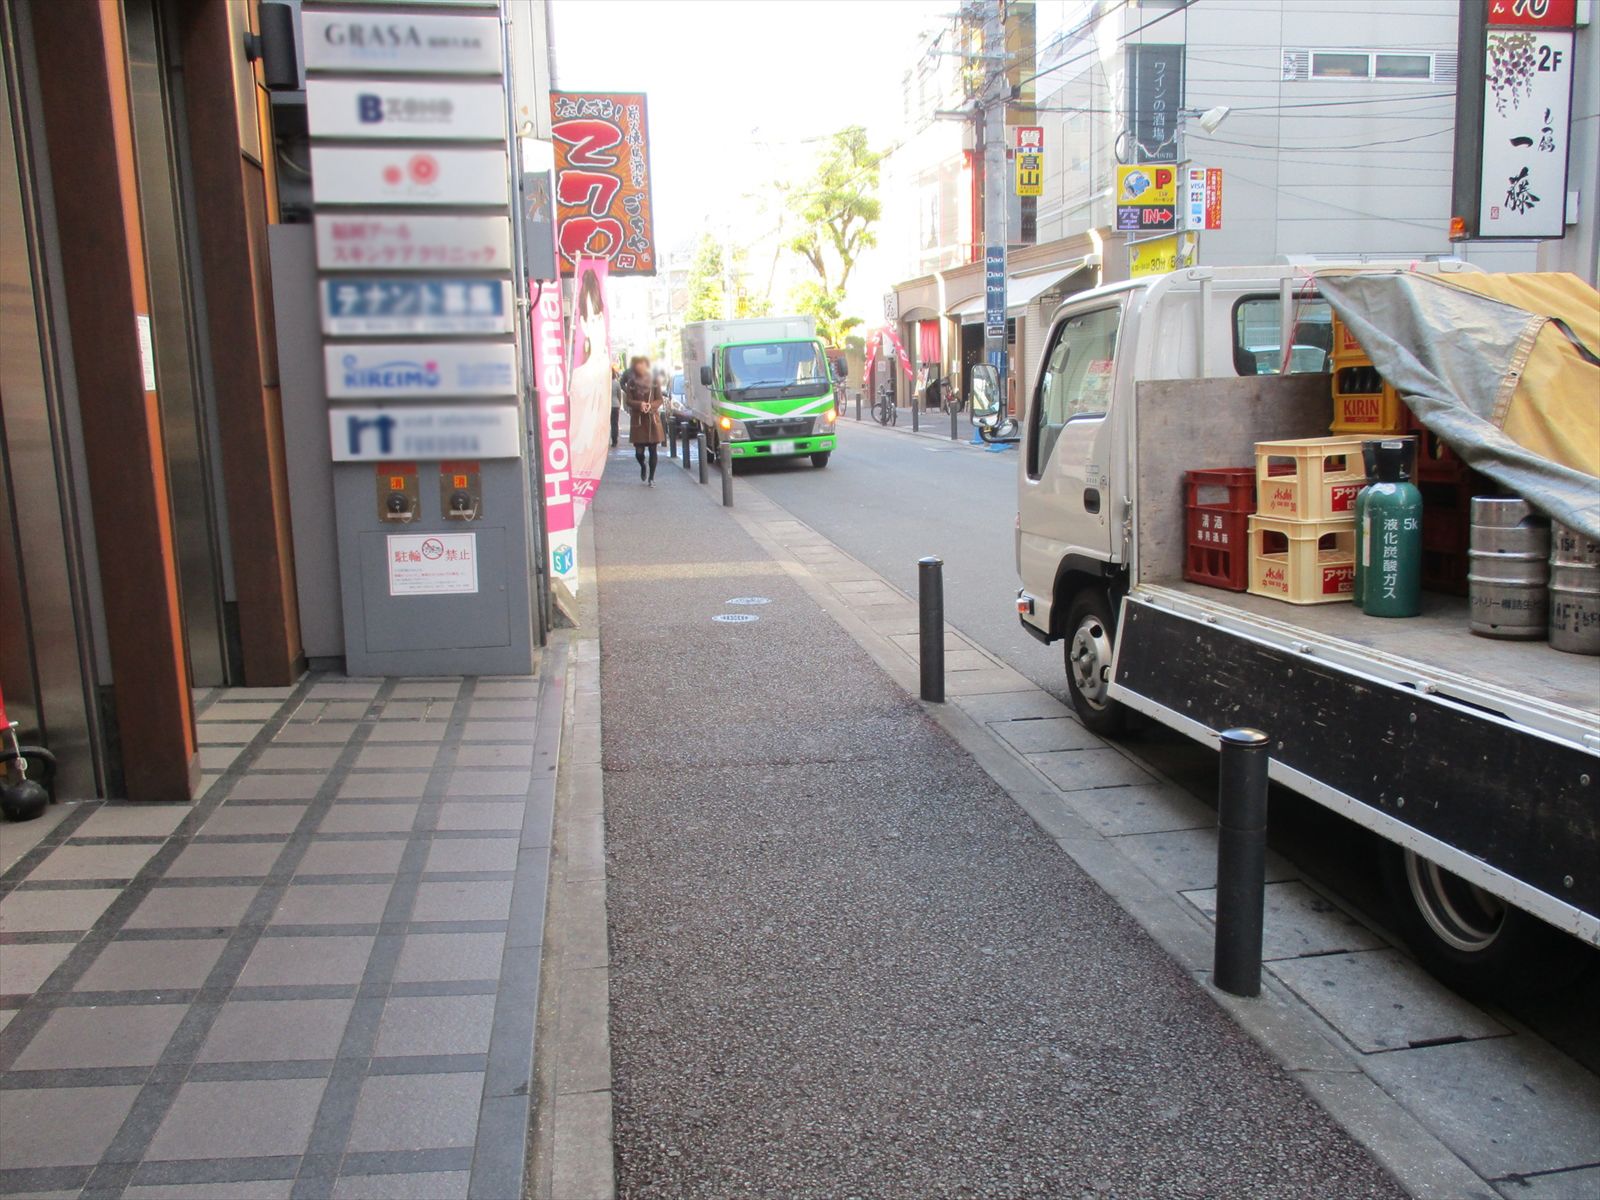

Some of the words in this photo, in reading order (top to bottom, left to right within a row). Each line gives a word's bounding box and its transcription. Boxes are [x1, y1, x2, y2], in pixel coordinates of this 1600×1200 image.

[324, 24, 421, 47] GRASA
[1538, 45, 1562, 72] 2F
[1152, 62, 1166, 141] ワインの酒場
[1020, 154, 1040, 185] 高山
[1503, 136, 1541, 215] 一藤
[1155, 169, 1172, 189] P
[1142, 208, 1159, 224] IN
[987, 256, 1003, 264] Dao
[1344, 400, 1379, 416] KIRIN
[1274, 488, 1293, 500] Asahi
[1334, 487, 1360, 500] アサ
[1202, 514, 1222, 528] 清酒
[1404, 519, 1418, 530] 5k
[395, 551, 421, 563] 駐輪
[446, 549, 470, 561] 禁止
[1383, 518, 1398, 599] 液化炭酸ガス
[1266, 567, 1284, 580] Asahi
